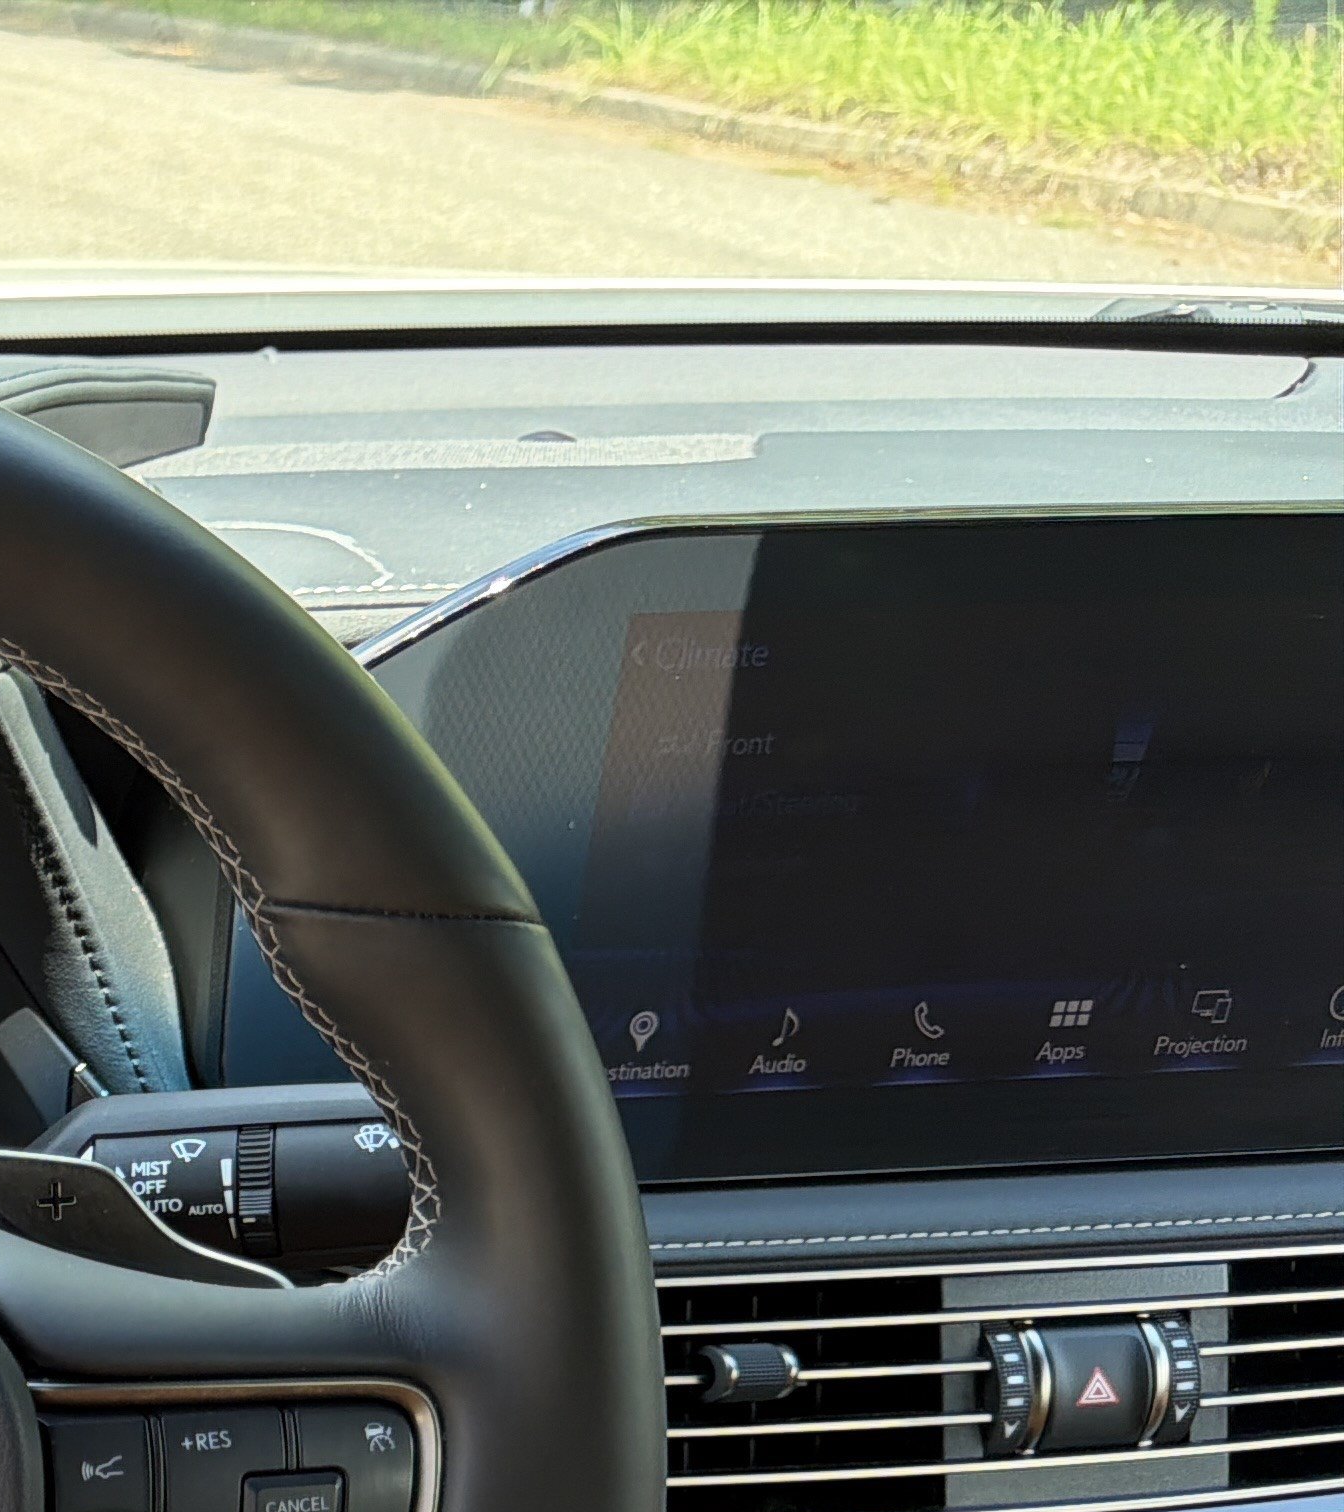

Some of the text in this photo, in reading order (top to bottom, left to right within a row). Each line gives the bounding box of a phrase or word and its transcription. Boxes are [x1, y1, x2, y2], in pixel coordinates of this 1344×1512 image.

[1035, 1040, 1087, 1064] Apps
[1153, 1033, 1248, 1059] Projection
[748, 1053, 807, 1075] Audio
[889, 1047, 950, 1068] Phone
[130, 1160, 172, 1178] MIST
[132, 1179, 167, 1196] OFF
[188, 1203, 224, 1216] AUTO
